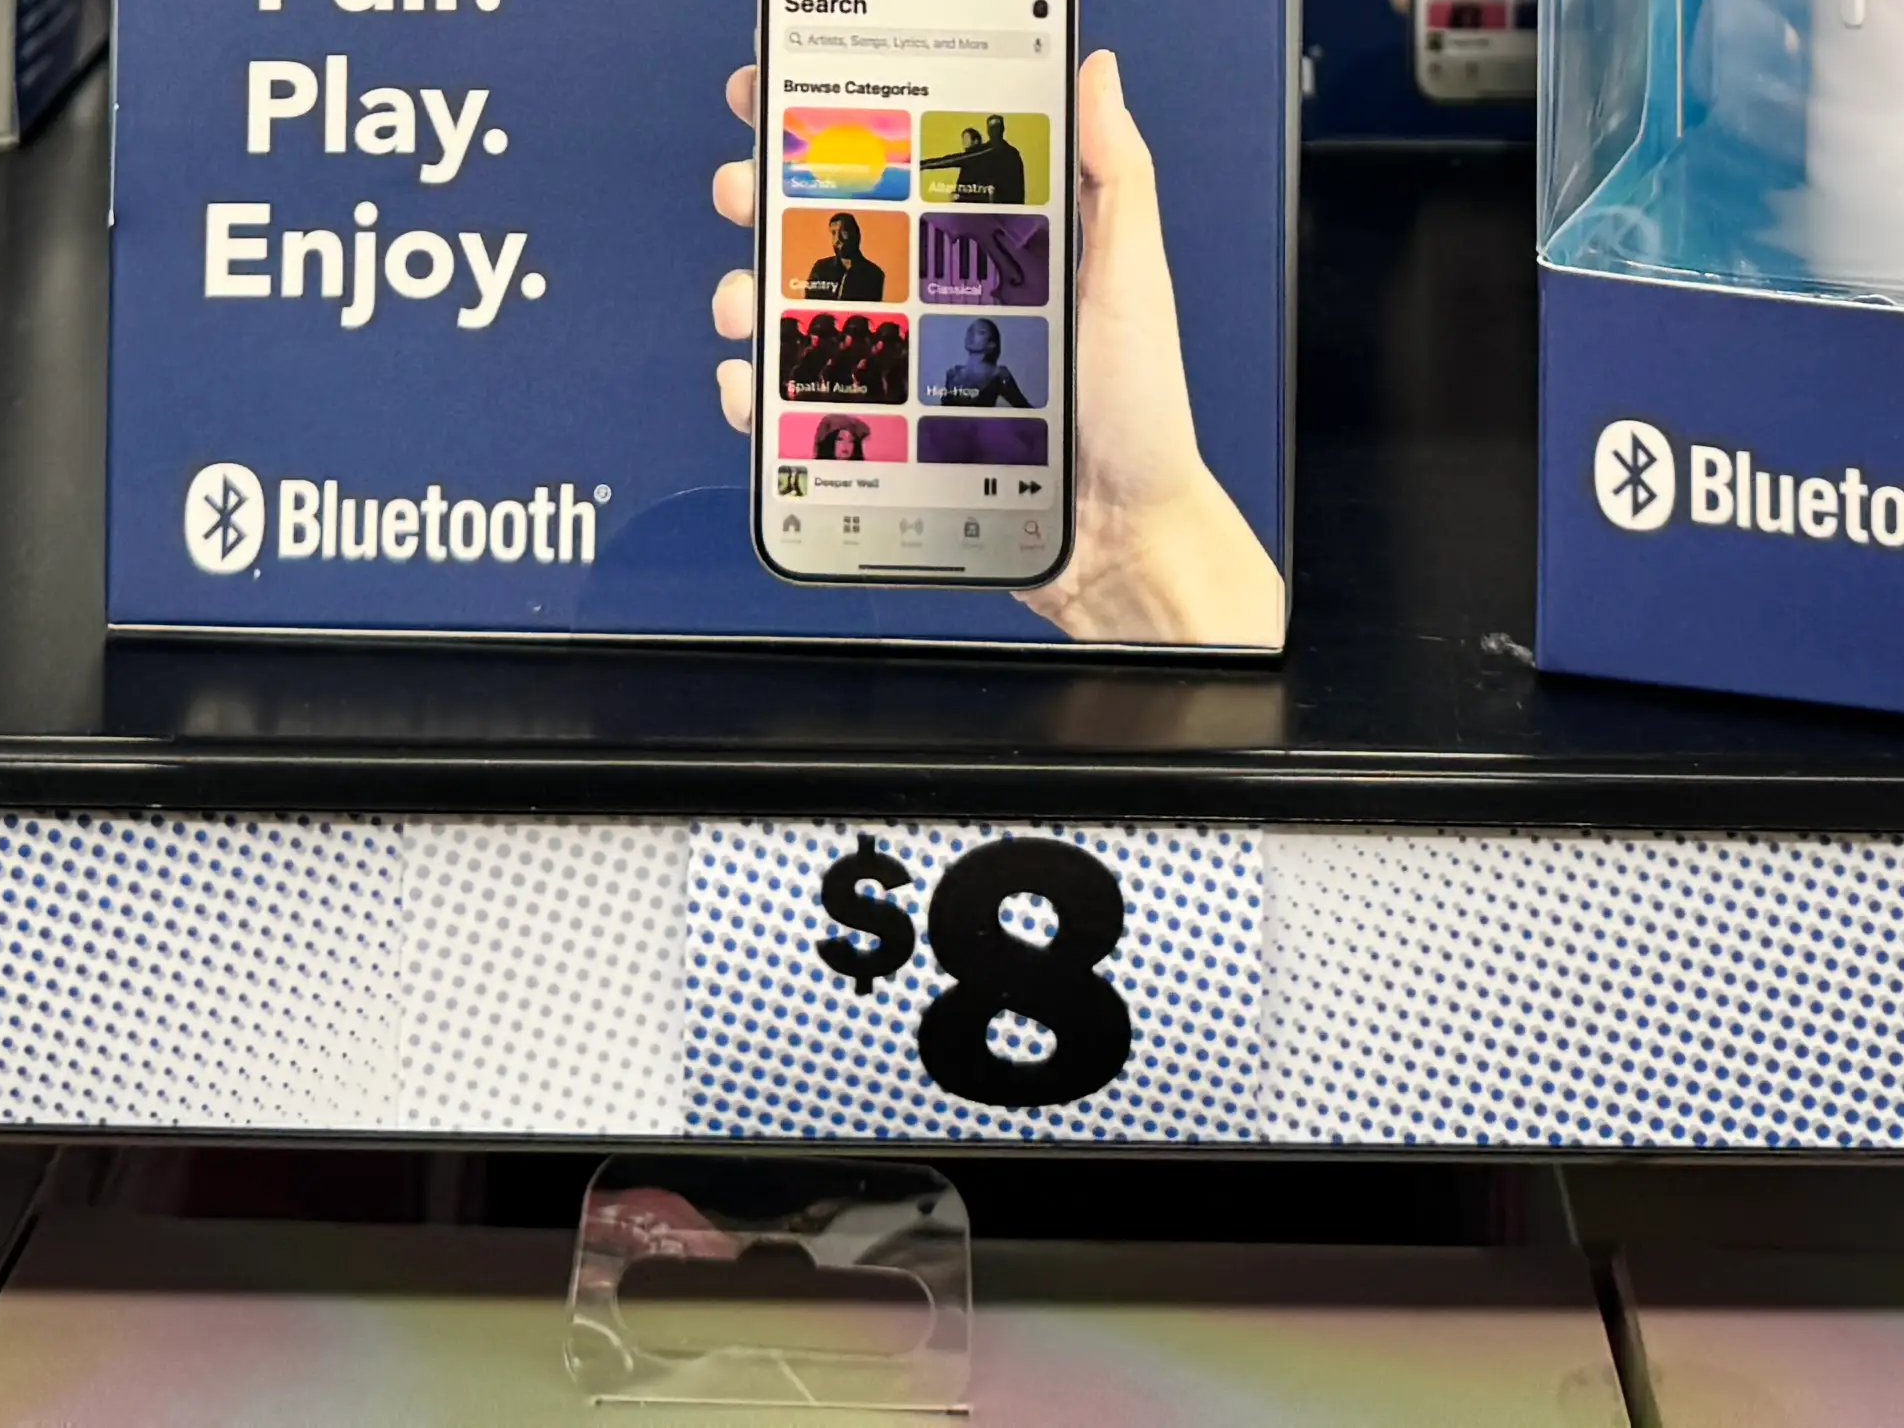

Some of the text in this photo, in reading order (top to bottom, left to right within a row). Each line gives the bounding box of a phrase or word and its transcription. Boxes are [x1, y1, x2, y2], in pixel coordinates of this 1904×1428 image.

[247, 55, 508, 185] Play.
[783, 80, 930, 99] Browse Categories
[204, 201, 546, 329] Enjoy.
[816, 834, 1133, 1108] $8
